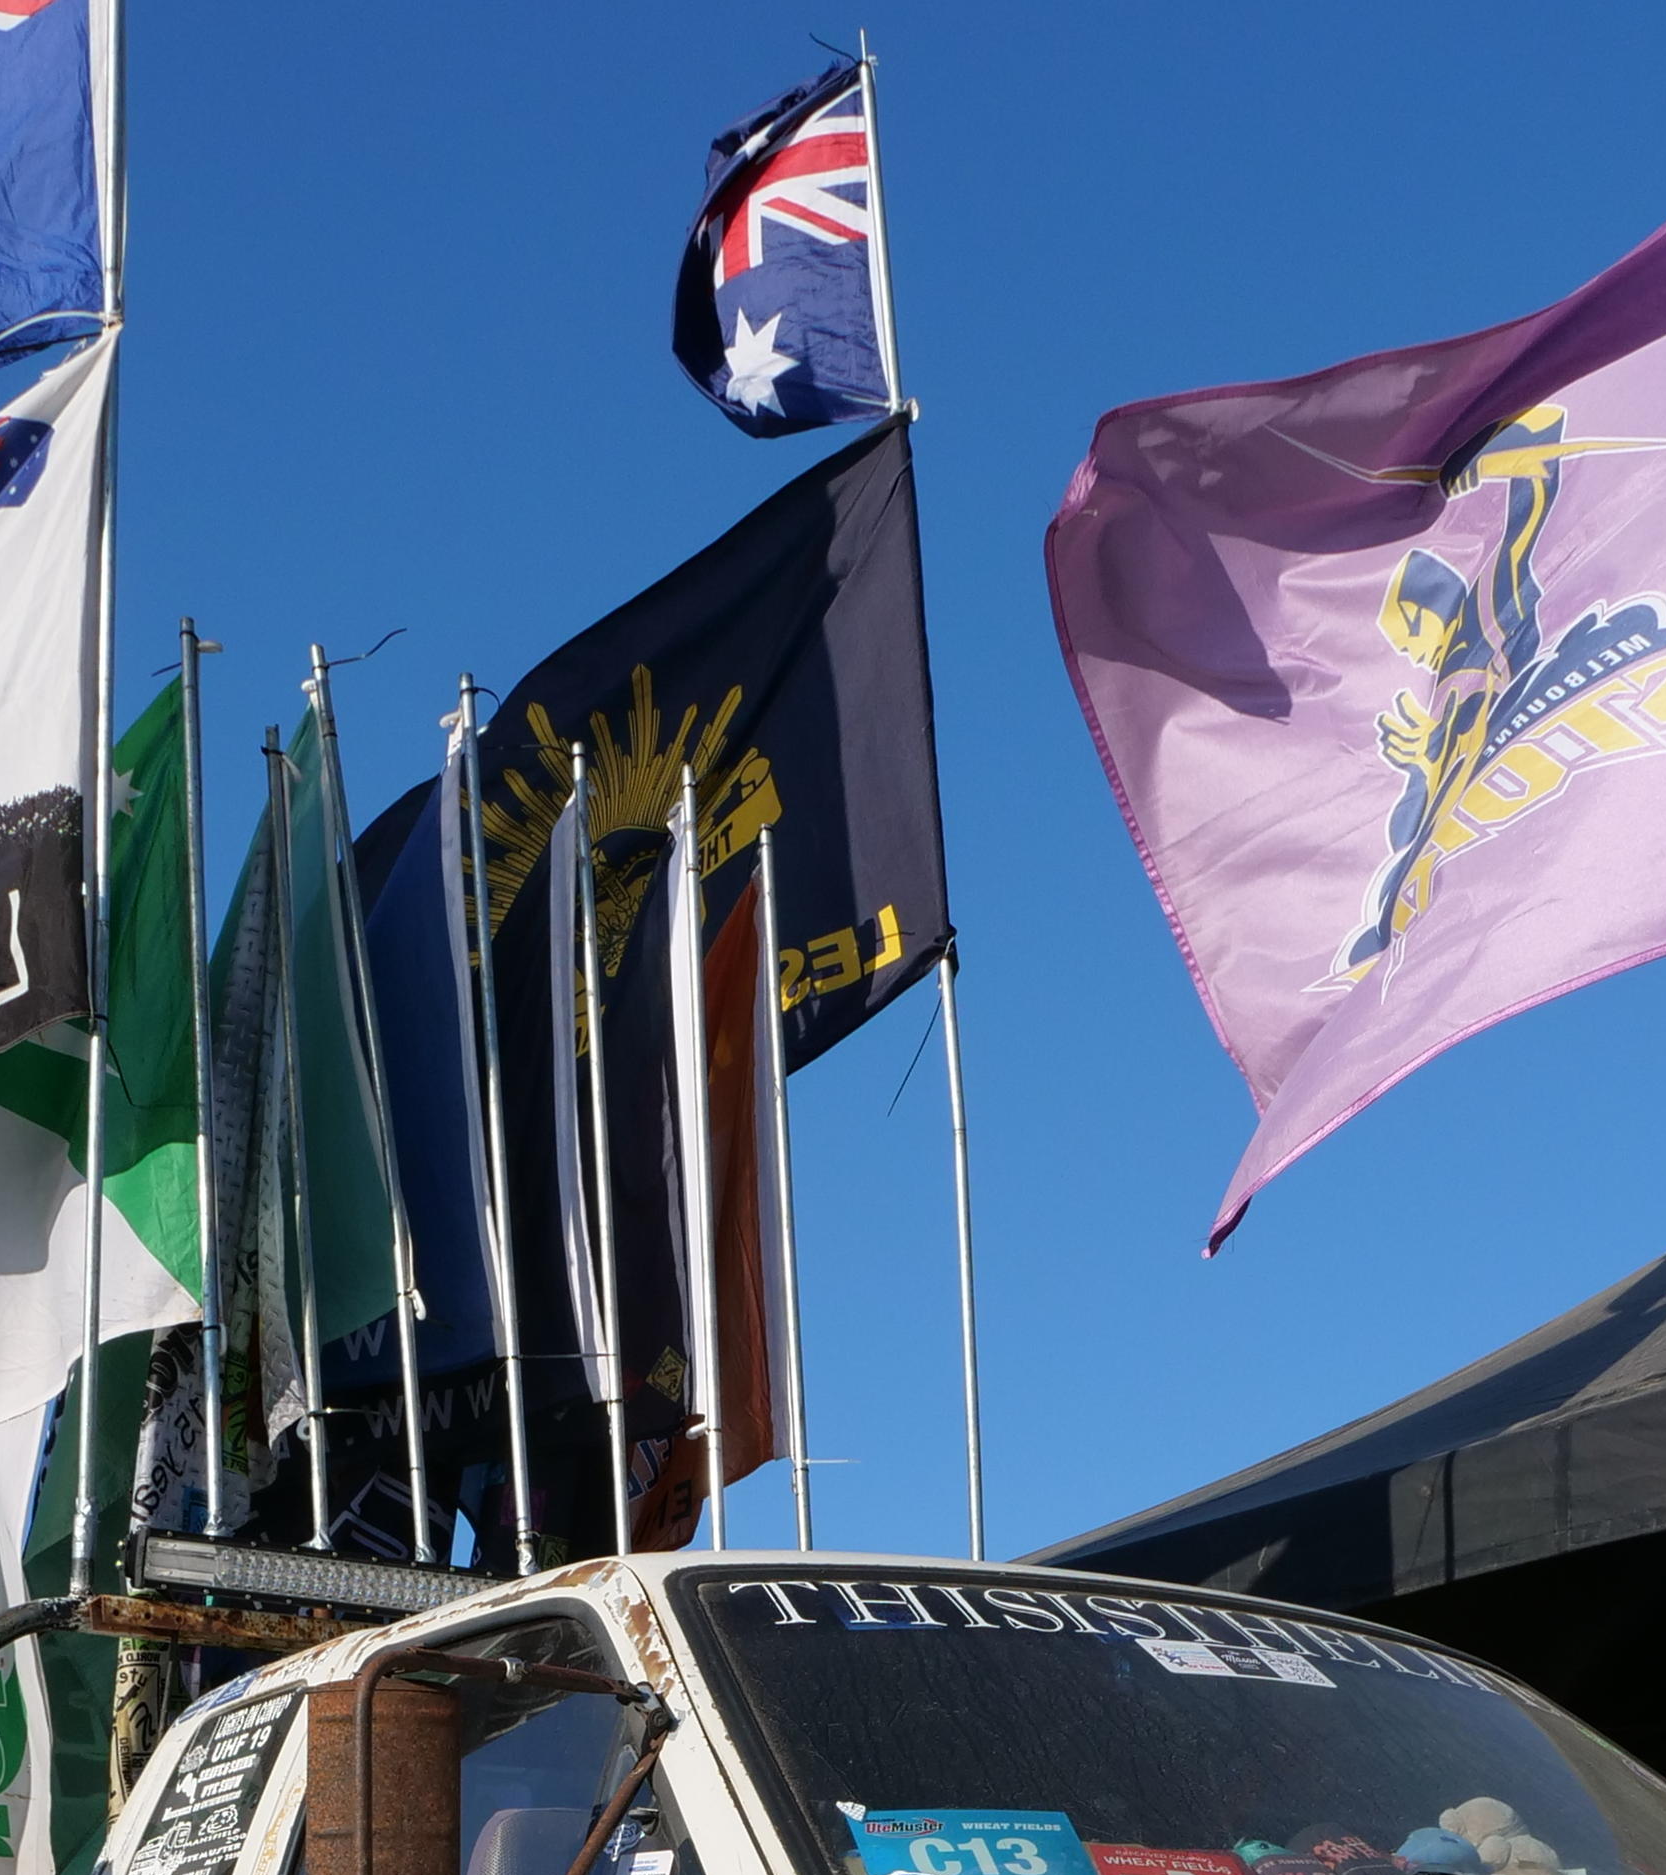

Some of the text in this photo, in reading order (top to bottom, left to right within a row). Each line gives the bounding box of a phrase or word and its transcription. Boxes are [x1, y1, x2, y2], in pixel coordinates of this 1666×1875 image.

[211, 1726, 272, 1763] UHF 19
[962, 1822, 1061, 1832] WHEAT FIELDS
[183, 1828, 242, 1847] MANSFIELD
[1103, 1856, 1232, 1875] WHEAT FIELDS
